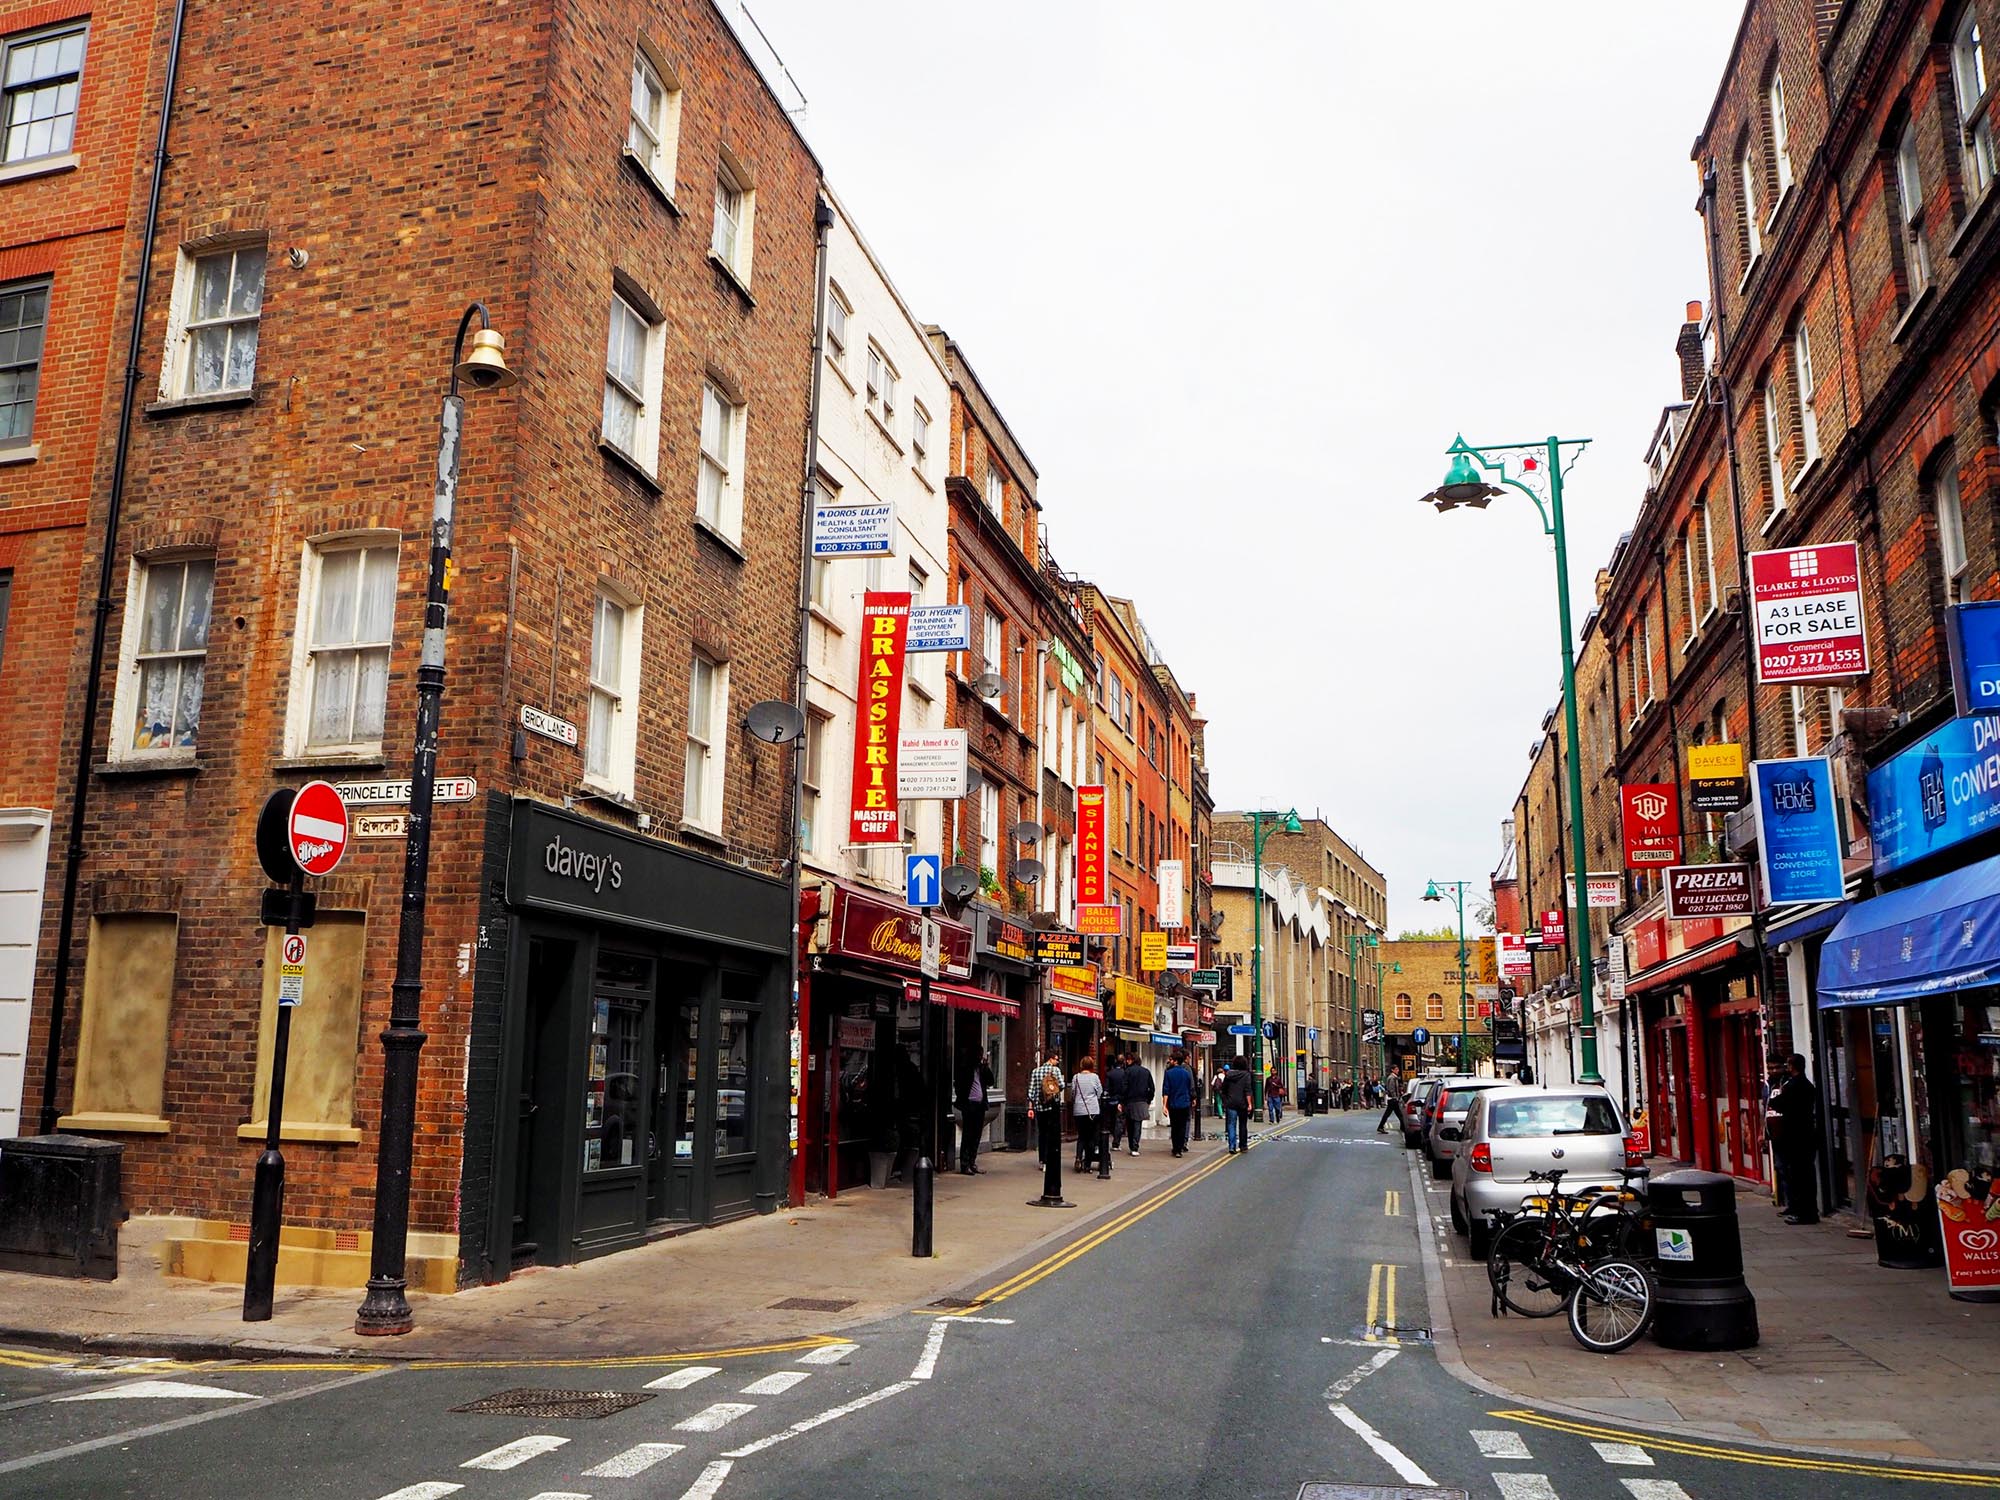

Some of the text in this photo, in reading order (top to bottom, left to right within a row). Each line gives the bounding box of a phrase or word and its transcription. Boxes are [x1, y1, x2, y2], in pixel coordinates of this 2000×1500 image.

[860, 508, 890, 516] ULLAH
[1756, 581, 1798, 592] CLARKE
[1813, 575, 1856, 586] LLOYDS
[1801, 587, 1840, 595] CONSULTANTS
[865, 606, 908, 615] BRICK LANE
[929, 608, 963, 616] HYGIENE
[1770, 600, 1847, 618] A3 LEASE
[910, 624, 957, 632] EMPLOYMENT
[1764, 616, 1856, 637] FOR SALE
[1788, 640, 1834, 652] Commercial
[1764, 649, 1861, 668] 0207 377 1555
[1764, 661, 1862, 676] www.clarkeandlloyds.co.uk
[865, 617, 896, 808] BRASSERIE
[526, 710, 546, 730] BRICK
[548, 719, 566, 738] LANE
[922, 739, 942, 747] Ahmed
[950, 738, 959, 746] Co
[1694, 755, 1736, 764] DAVEYS
[1921, 768, 1944, 798] TALK
[336, 786, 402, 800] PRINCELET
[1773, 781, 1812, 796] TALK
[1775, 794, 1814, 810] HOME
[1924, 791, 1945, 822] HOME
[854, 810, 896, 822] MASTER
[861, 822, 888, 832] CHEF
[1630, 838, 1674, 846] STORES
[1085, 809, 1098, 896] STANDARD
[1634, 851, 1672, 860] SUPERMARKET
[1776, 850, 1828, 860] DAILY NEEDS
[544, 835, 622, 894] davey's
[1774, 859, 1832, 870] CONVENIENCE
[1790, 870, 1817, 878] STORE
[1675, 872, 1744, 889] PREEM
[1166, 872, 1176, 920] VILLAGE
[1679, 894, 1749, 904] FULLY LICENCED
[1086, 907, 1113, 916] BALTI
[1081, 916, 1116, 926] HOUSE
[1544, 926, 1553, 934] TO
[1038, 934, 1080, 944] AZEEM
[1056, 951, 1081, 960] STYLES
[1210, 951, 1242, 967] MAN
[1404, 1060, 1412, 1070] P
[1963, 1252, 1998, 1260] WALL'S
